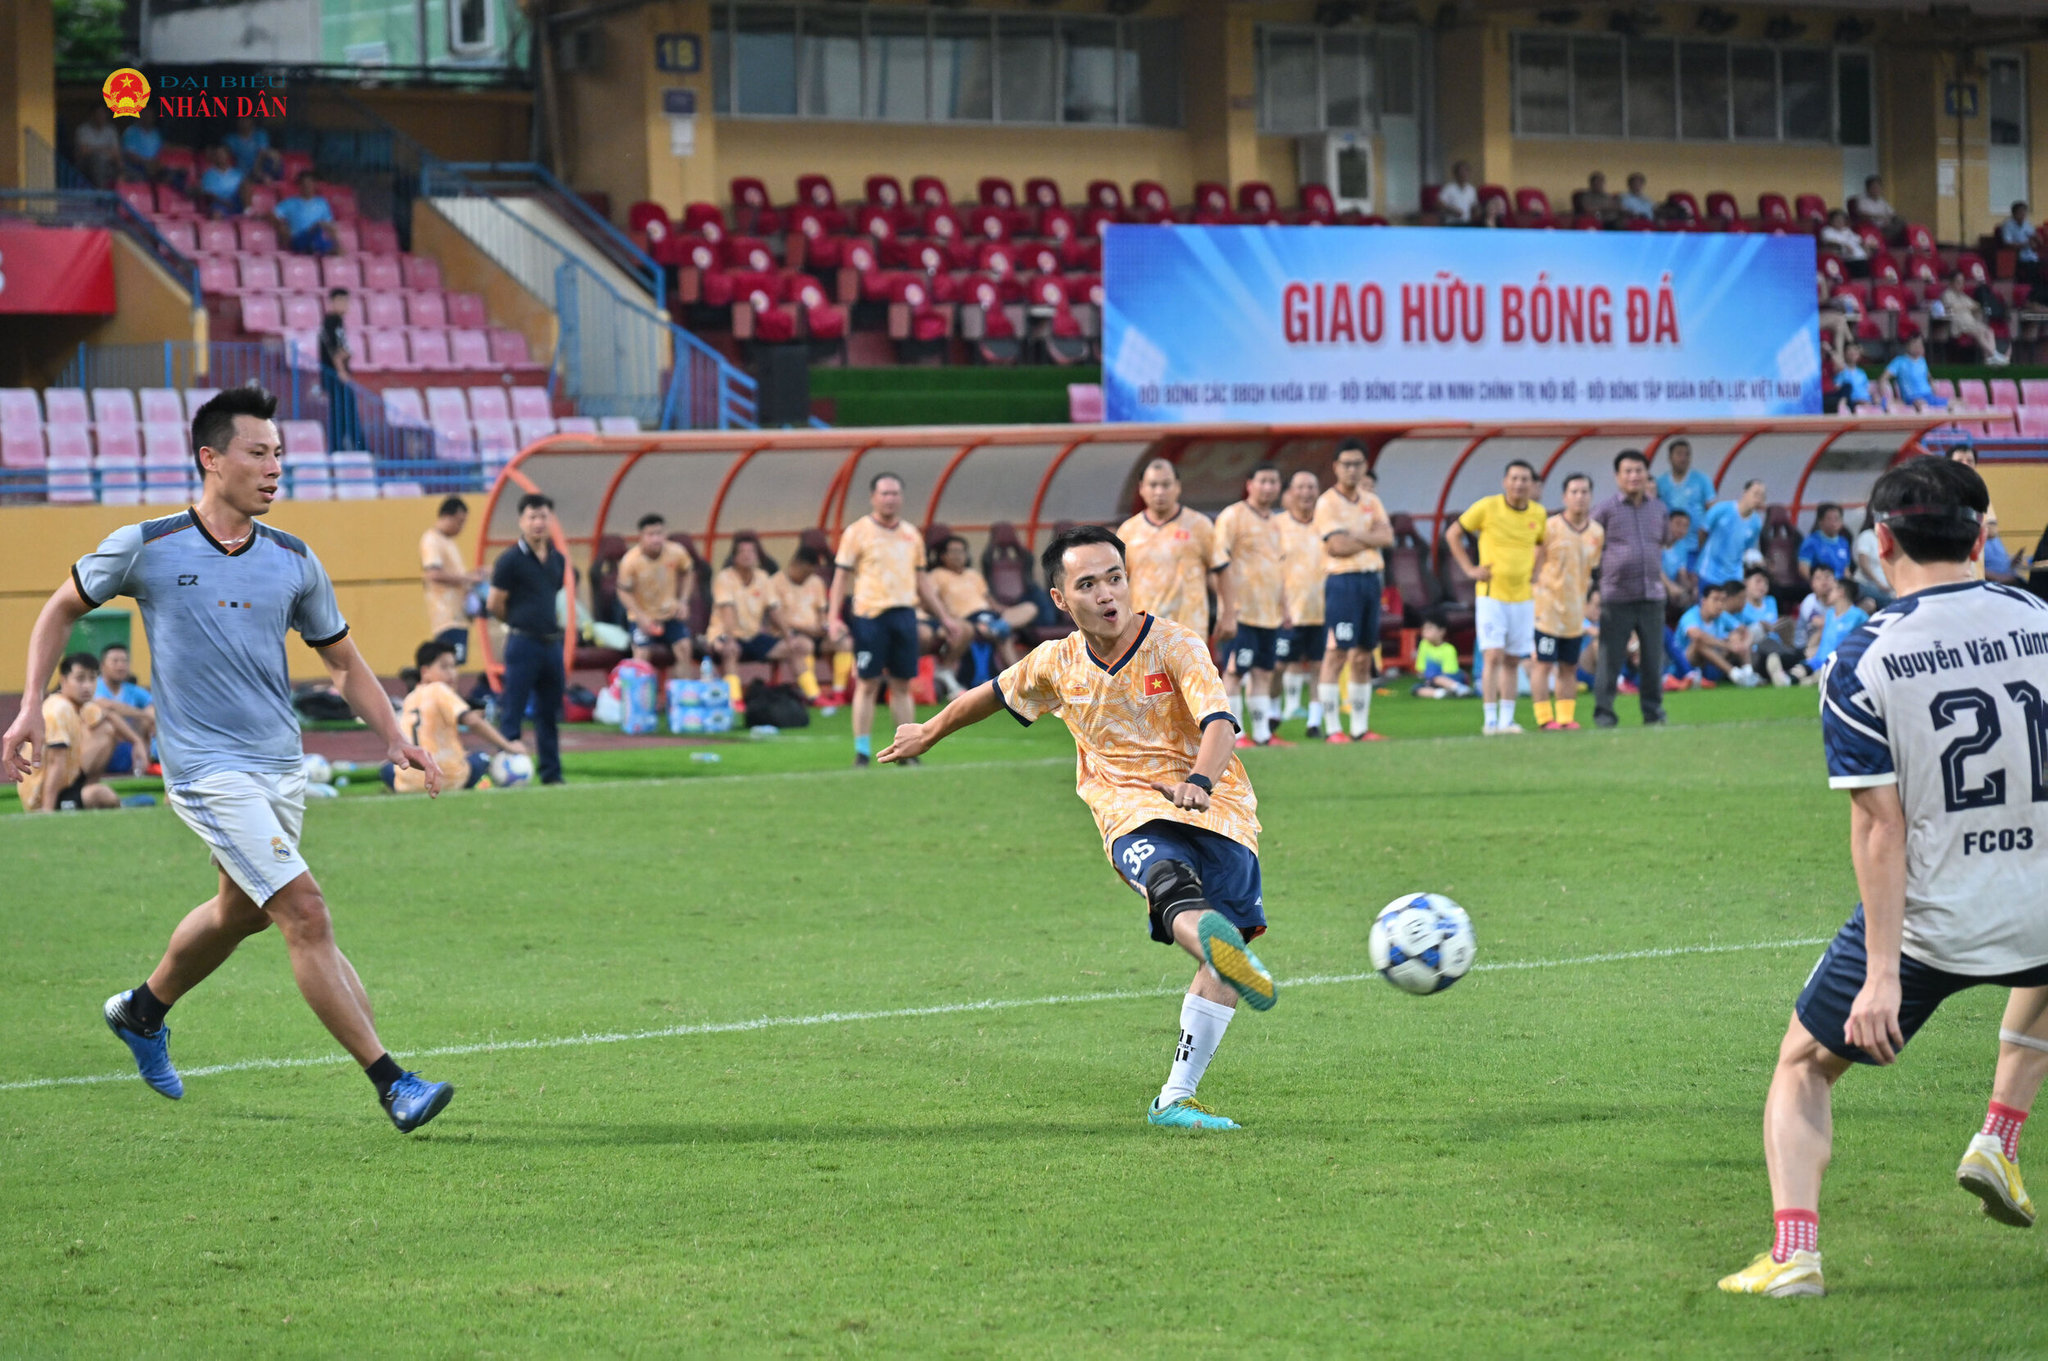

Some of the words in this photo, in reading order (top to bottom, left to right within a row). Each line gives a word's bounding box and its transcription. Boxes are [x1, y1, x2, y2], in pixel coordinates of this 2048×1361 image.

[1282, 281, 1385, 345] GIAO
[1401, 270, 1486, 345] HỮU
[1502, 271, 1612, 345] BÓNG
[1626, 271, 1680, 345] ĐÁ
[1882, 640, 1964, 681] Nguyễn
[1965, 638, 2009, 667] Văn
[1929, 680, 2048, 813] 21
[1122, 838, 1156, 876] 35
[1963, 827, 2034, 856] FC03
